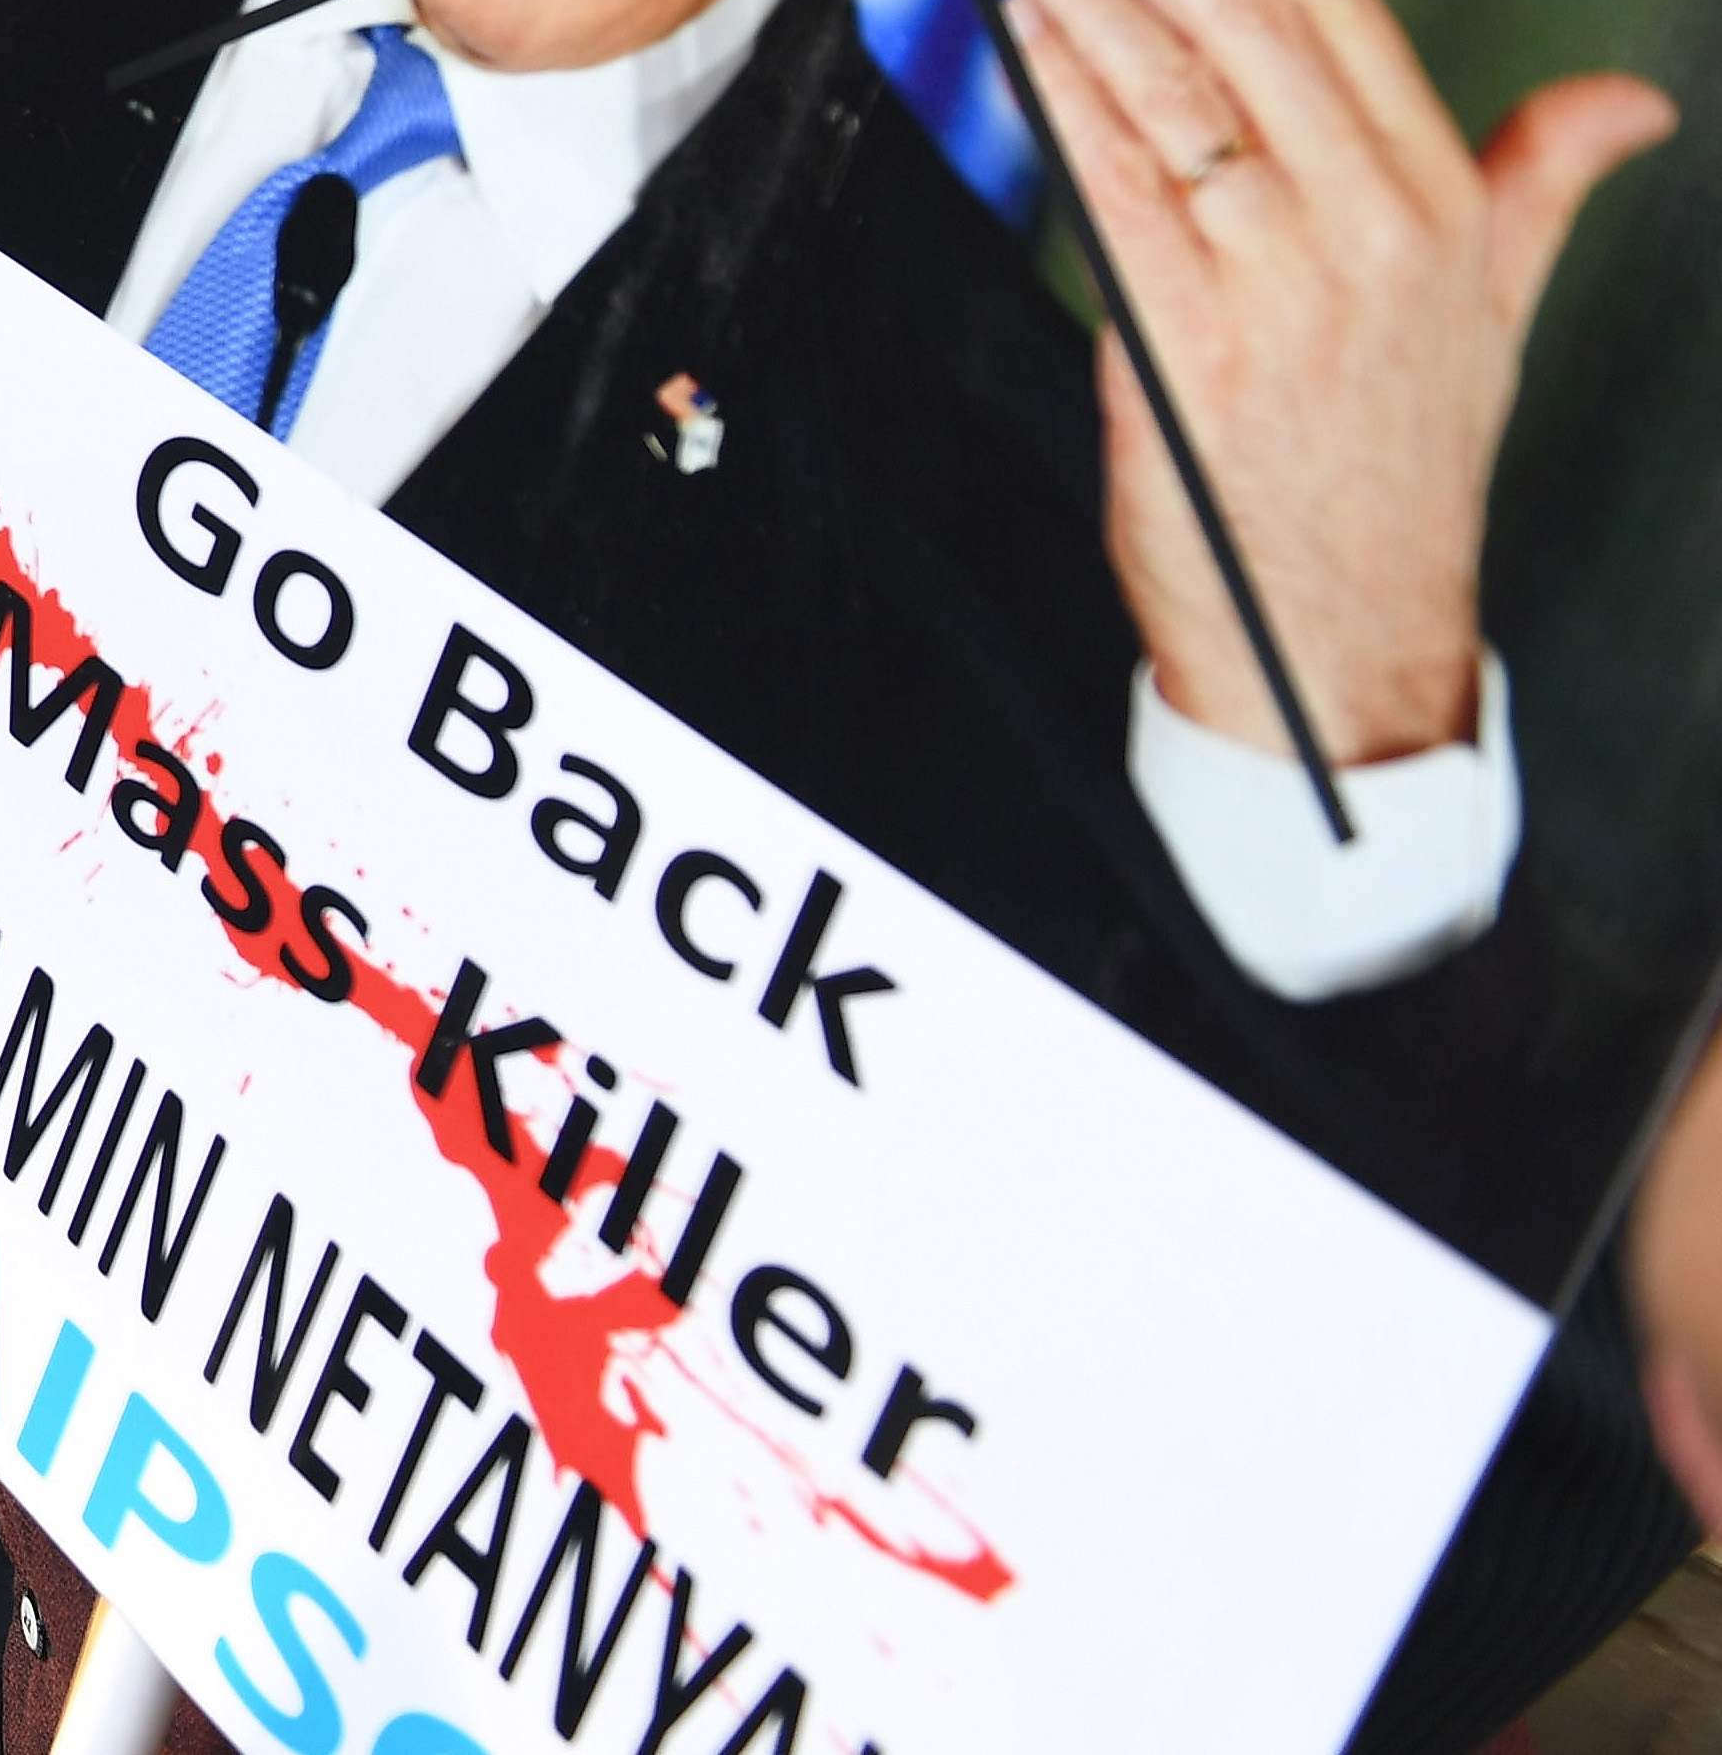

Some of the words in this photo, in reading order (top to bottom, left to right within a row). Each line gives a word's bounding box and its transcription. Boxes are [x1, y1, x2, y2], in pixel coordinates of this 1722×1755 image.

[134, 435, 357, 673] Go
[407, 623, 899, 1090] Back
[202, 1192, 888, 1755] NETANY
[417, 957, 980, 1485] Killer
